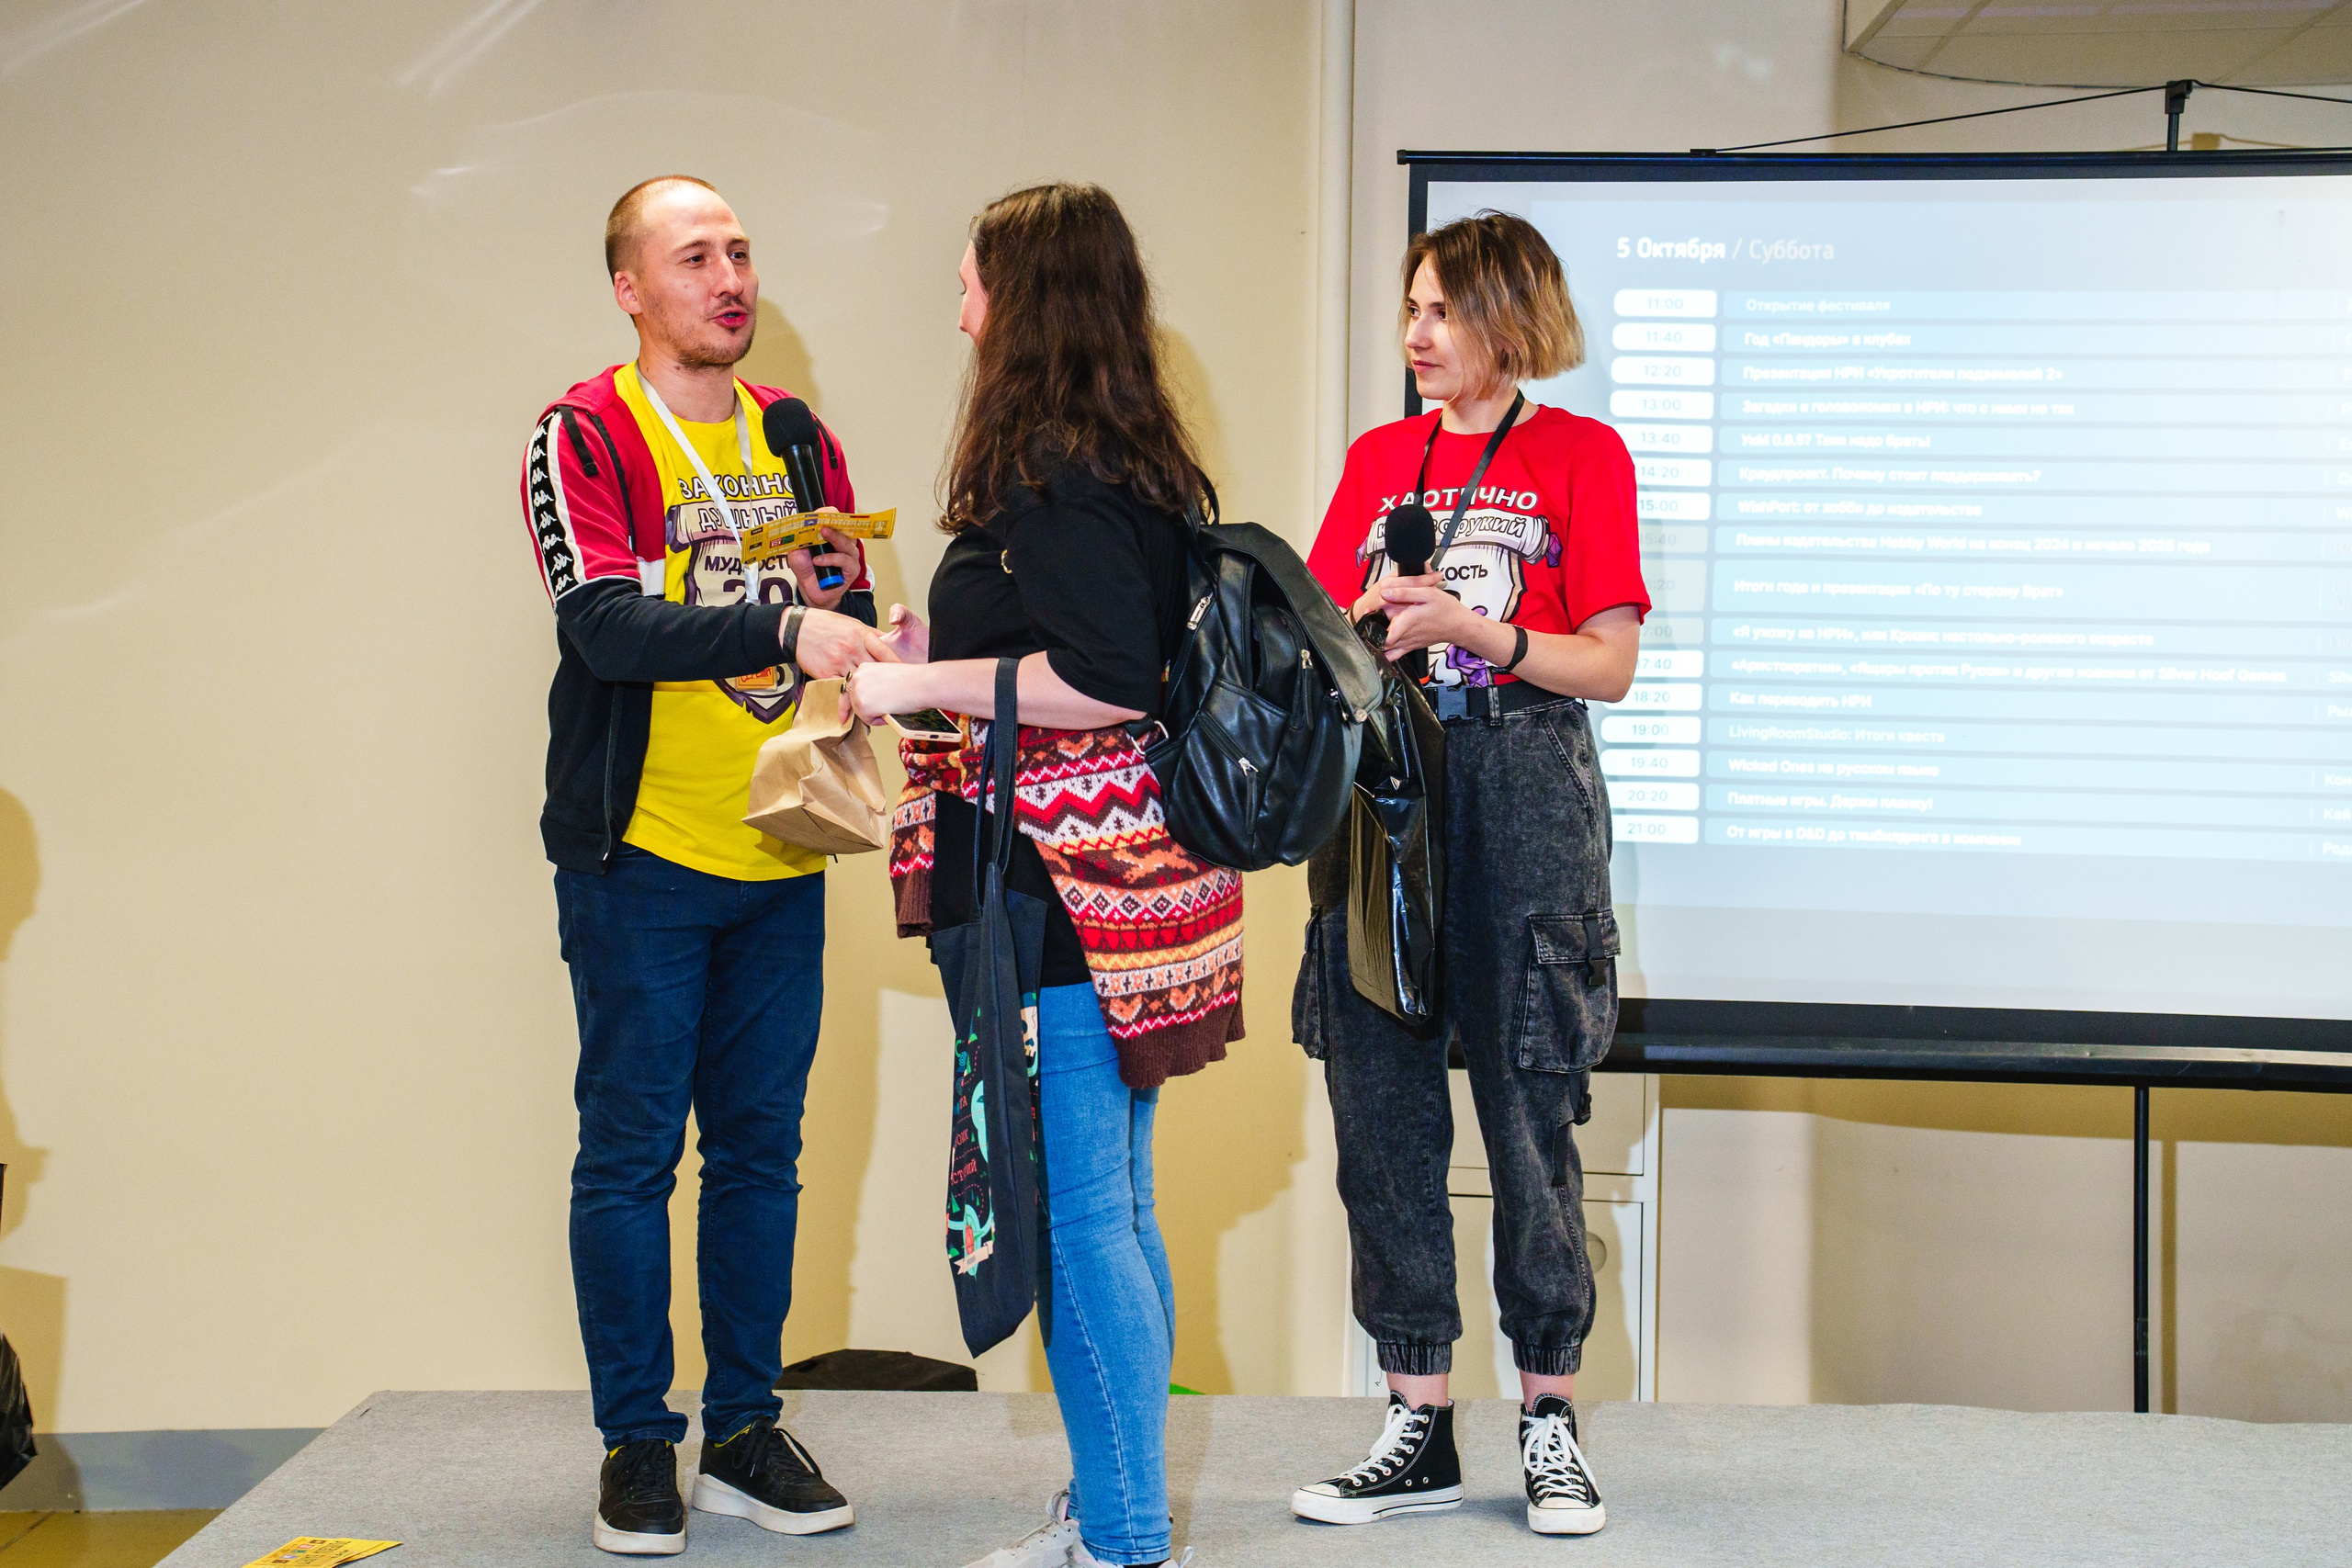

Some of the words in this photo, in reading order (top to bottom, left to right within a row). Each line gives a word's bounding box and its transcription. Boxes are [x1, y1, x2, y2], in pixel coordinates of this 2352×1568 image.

[1616, 238, 1630, 258] 5
[1636, 236, 1725, 264] Октября
[1748, 240, 1834, 264] Суббота
[1745, 299, 1815, 313] Открытие
[1816, 299, 1890, 313] фестиваля
[1645, 332, 1683, 344] 11:40
[1744, 333, 1770, 347] Год
[1851, 335, 1860, 345] в
[1862, 332, 1911, 347] клубах
[1643, 365, 1682, 378] 12:20
[1743, 367, 1832, 382] Презентация
[1834, 366, 1864, 378] НРИ
[1956, 367, 2042, 382] подземелий
[1641, 399, 1681, 412] 13:00
[1742, 400, 1797, 414] Загадки
[1799, 402, 1809, 412] и
[1811, 401, 1901, 413] головоломки
[1903, 402, 1913, 414] в
[1952, 403, 1977, 413] что
[1978, 403, 1988, 414] с
[2030, 404, 2048, 414] не
[2050, 403, 2075, 414] так
[1640, 433, 1681, 445] 13:40
[1815, 433, 1847, 446] Таки
[1848, 435, 1883, 448] надо
[1884, 434, 1930, 449] брать!
[1639, 467, 1679, 479] 14:20
[1831, 467, 1886, 483] Почему
[1888, 470, 1928, 481] стоит
[1930, 468, 2041, 485] поддерживать?
[1638, 500, 1679, 512] 15:00
[1803, 502, 1819, 513] от
[1822, 500, 1863, 514] хобби
[1864, 503, 1885, 515] до
[1886, 504, 1982, 517] издательства
[1736, 534, 1781, 547] Планы
[1782, 536, 1877, 549] издательства
[1879, 536, 1924, 551] Hobby
[1927, 536, 1966, 549] World
[1968, 539, 1986, 549] на
[1988, 539, 2030, 552] конец
[2033, 537, 2069, 551] 2024
[2072, 541, 2082, 550] и
[2084, 540, 2135, 552] начало
[2137, 538, 2175, 552] 2025
[2177, 541, 2211, 554] года
[705, 553, 791, 575] МУДСТ
[1734, 580, 1774, 592] Итоги
[1776, 582, 1808, 594] года
[1810, 583, 1820, 593] и
[1822, 583, 1911, 598] презентация
[1943, 586, 1960, 599] ту
[1962, 586, 2020, 600] сторону
[1752, 627, 1795, 641] ухожу
[1797, 628, 1815, 638] из
[1860, 630, 1887, 641] или
[1889, 628, 1939, 644] Кризис
[2088, 634, 2154, 648] возраста
[1908, 664, 1958, 678] против
[2012, 667, 2022, 676] и
[2023, 668, 2075, 682] другие
[2076, 668, 2136, 679] новинки
[2138, 669, 2155, 680] от
[2157, 667, 2198, 681] Silver
[2199, 667, 2234, 682] Hoof
[2236, 669, 2287, 682] Games
[1633, 691, 1671, 704] 18:20
[1729, 692, 1755, 705] Как
[1757, 695, 1839, 709] переводить
[1841, 694, 1871, 707] НРИ
[1631, 724, 1669, 736] 19:00
[1729, 726, 1851, 743] LivingRoomStudio:
[1854, 729, 1895, 741] Итоги
[1897, 731, 1945, 742] квеста
[1630, 757, 1668, 769] 19:40
[1727, 759, 1778, 773] Wicked
[1780, 761, 1815, 773] Ones
[1816, 763, 1834, 773] на
[1836, 763, 1894, 778] русском
[1896, 765, 1939, 776] языке
[1627, 790, 1668, 802] 20:20
[1727, 792, 1788, 807] Платные
[1829, 795, 1878, 810] Держи
[1880, 796, 1933, 812] планку!
[1626, 823, 1667, 836] 21:00
[1726, 826, 1745, 838] От
[1747, 828, 1781, 841] игры
[1784, 829, 1793, 840] в
[1795, 827, 1826, 840] D&D
[1826, 829, 1846, 842] до
[1940, 834, 1951, 844] в
[1952, 833, 2021, 846] компании
